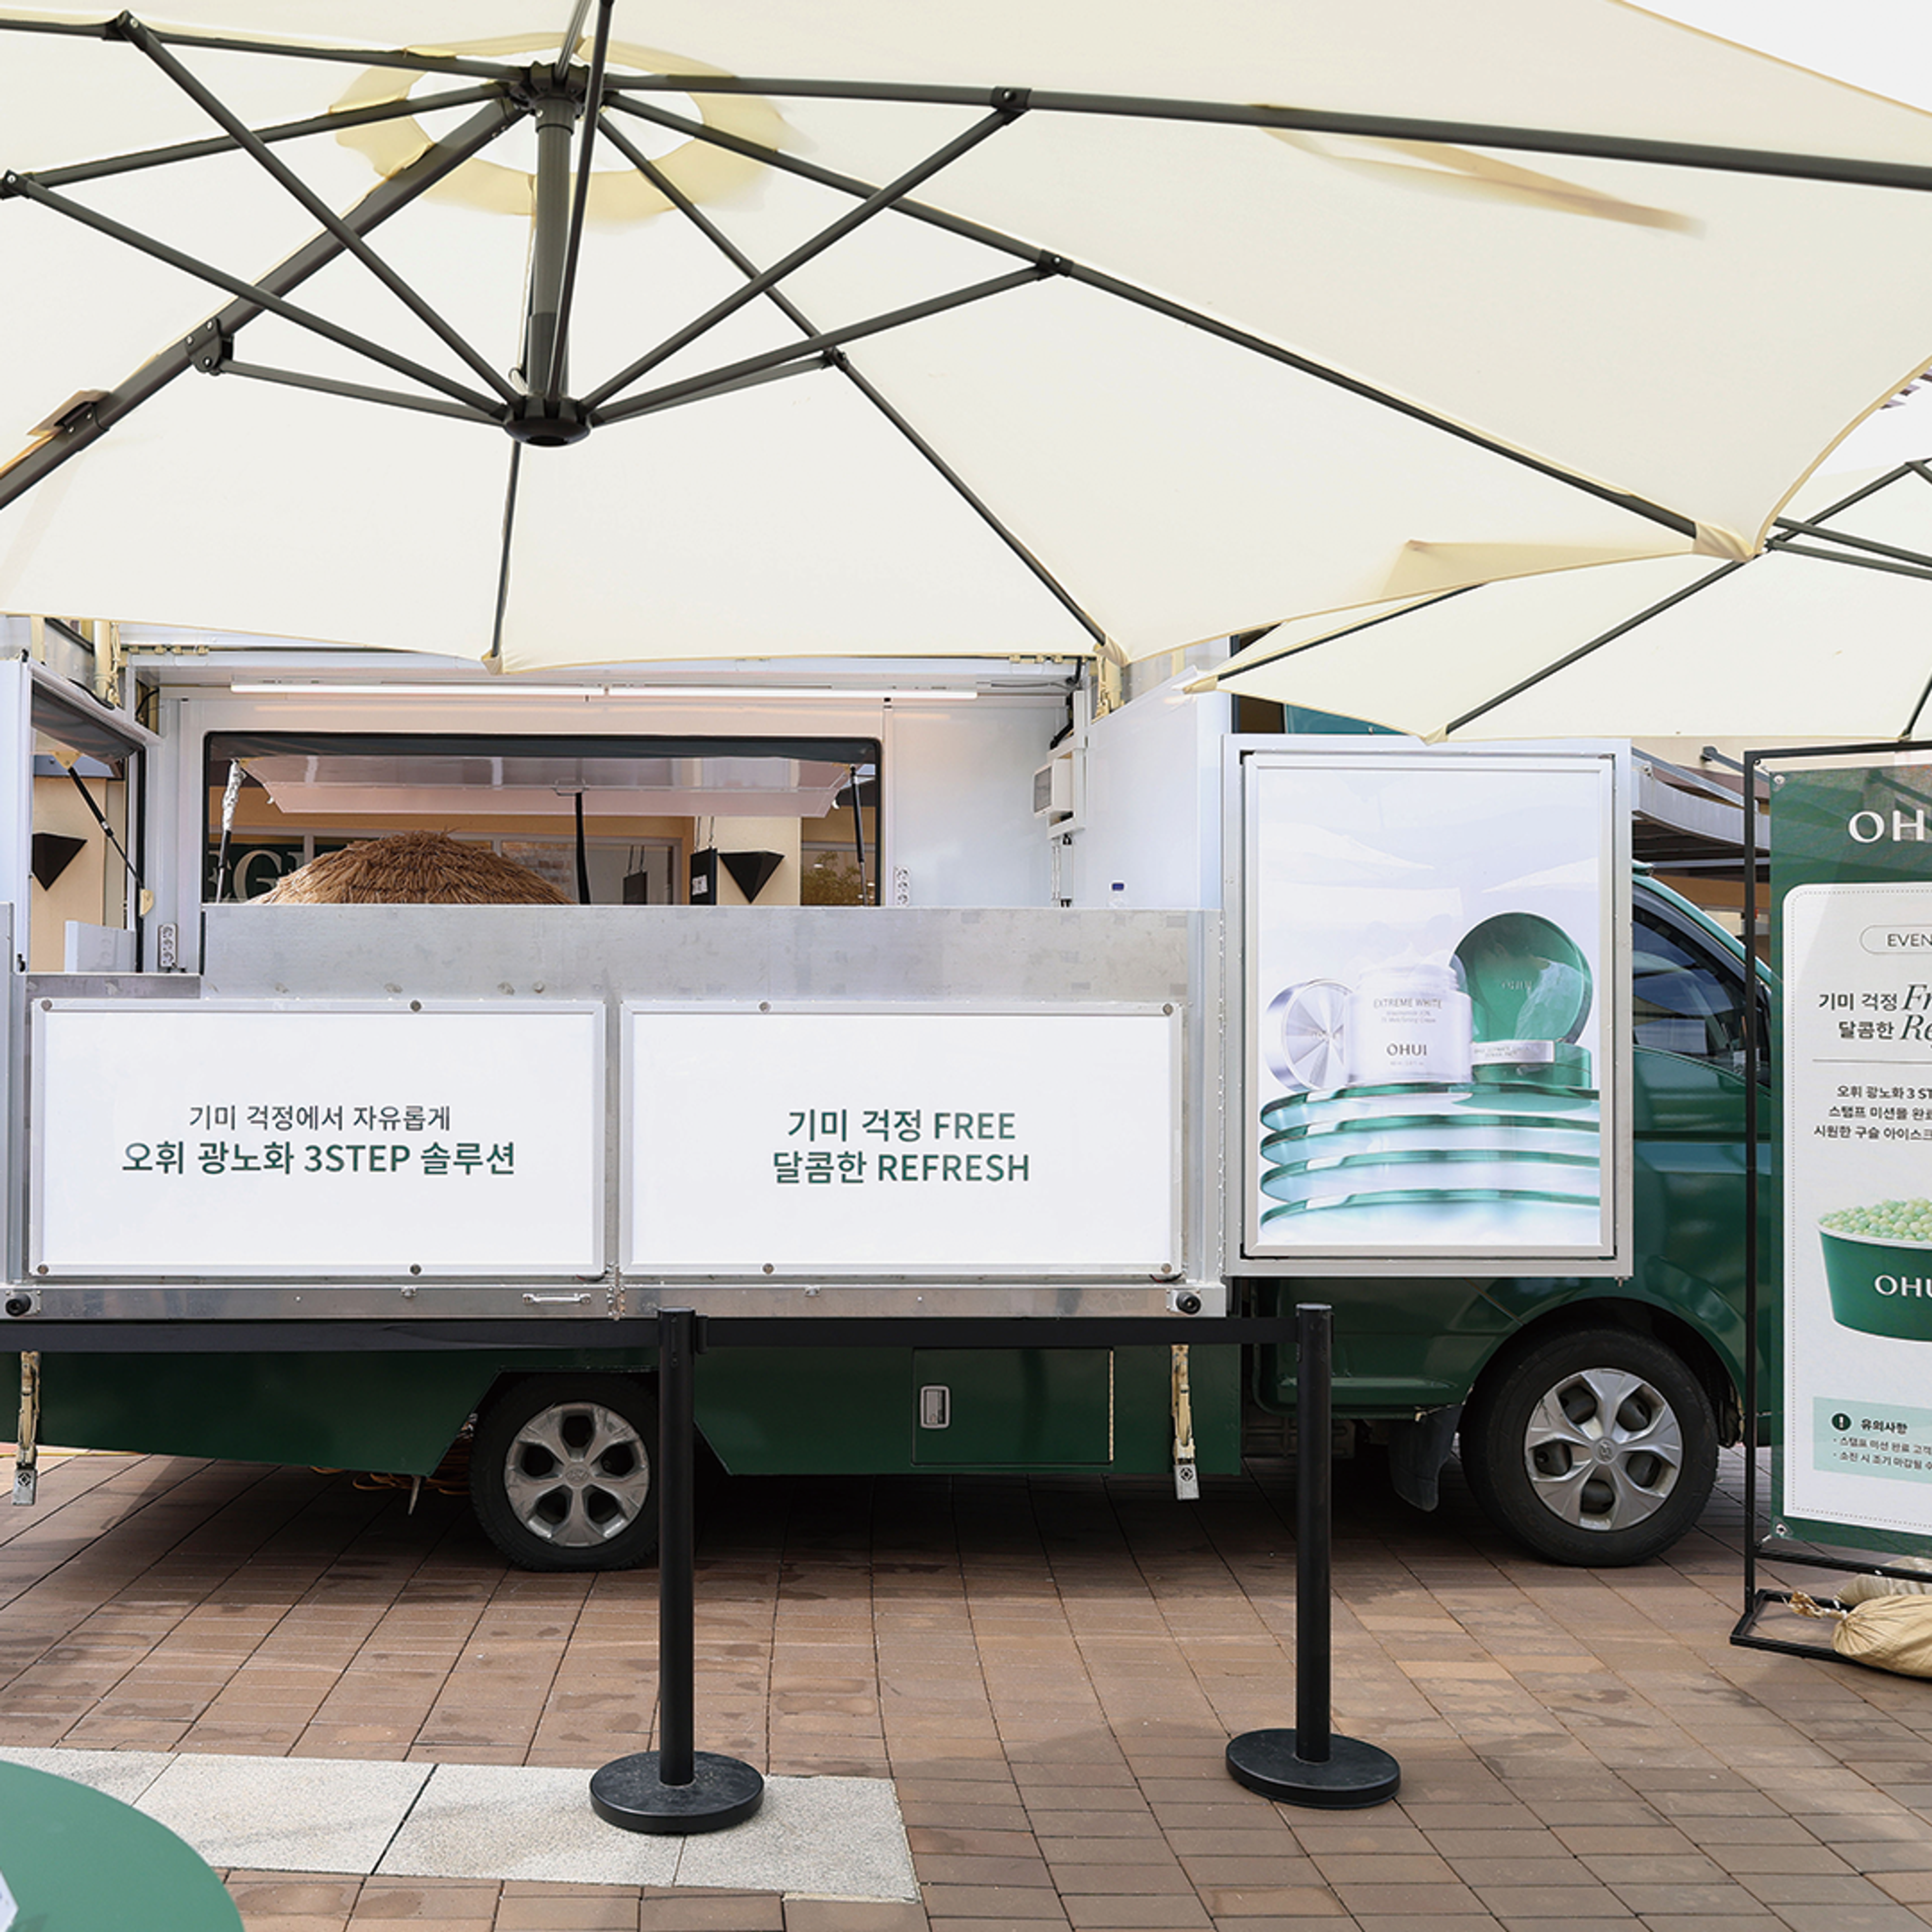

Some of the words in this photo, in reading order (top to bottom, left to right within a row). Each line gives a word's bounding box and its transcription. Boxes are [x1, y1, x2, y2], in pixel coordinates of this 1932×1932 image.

[1848, 810, 1924, 843] OH
[1887, 934, 1932, 947] EVEN
[1819, 993, 1854, 1011] 기미
[1862, 993, 1897, 1011] 걱정
[1838, 1021, 1895, 1040] 달콤한
[1386, 1043, 1427, 1056] OHUI
[1837, 1085, 1862, 1098] 오휘
[1866, 1086, 1904, 1099] 광노화
[190, 1105, 235, 1131] 기미
[247, 1105, 343, 1131] 걱정에서
[353, 1105, 450, 1131] 자유롭게
[1829, 1106, 1866, 1118] 스탬프
[1870, 1107, 1908, 1120] 미션을
[788, 1109, 847, 1142] 기미
[862, 1109, 921, 1142] 걱정
[934, 1112, 1015, 1140] FREE
[1814, 1125, 1851, 1139] 시원한
[1855, 1126, 1880, 1140] 구슬
[1883, 1128, 1932, 1141] 아이스크
[122, 1141, 184, 1175] 오휘
[198, 1141, 294, 1175] 광노화
[304, 1144, 411, 1172] 3STEP
[420, 1142, 514, 1176] 솔루션
[774, 1151, 867, 1184] 달콤한
[878, 1154, 1029, 1182] REFRESH
[1861, 1419, 1908, 1435] 유의사항
